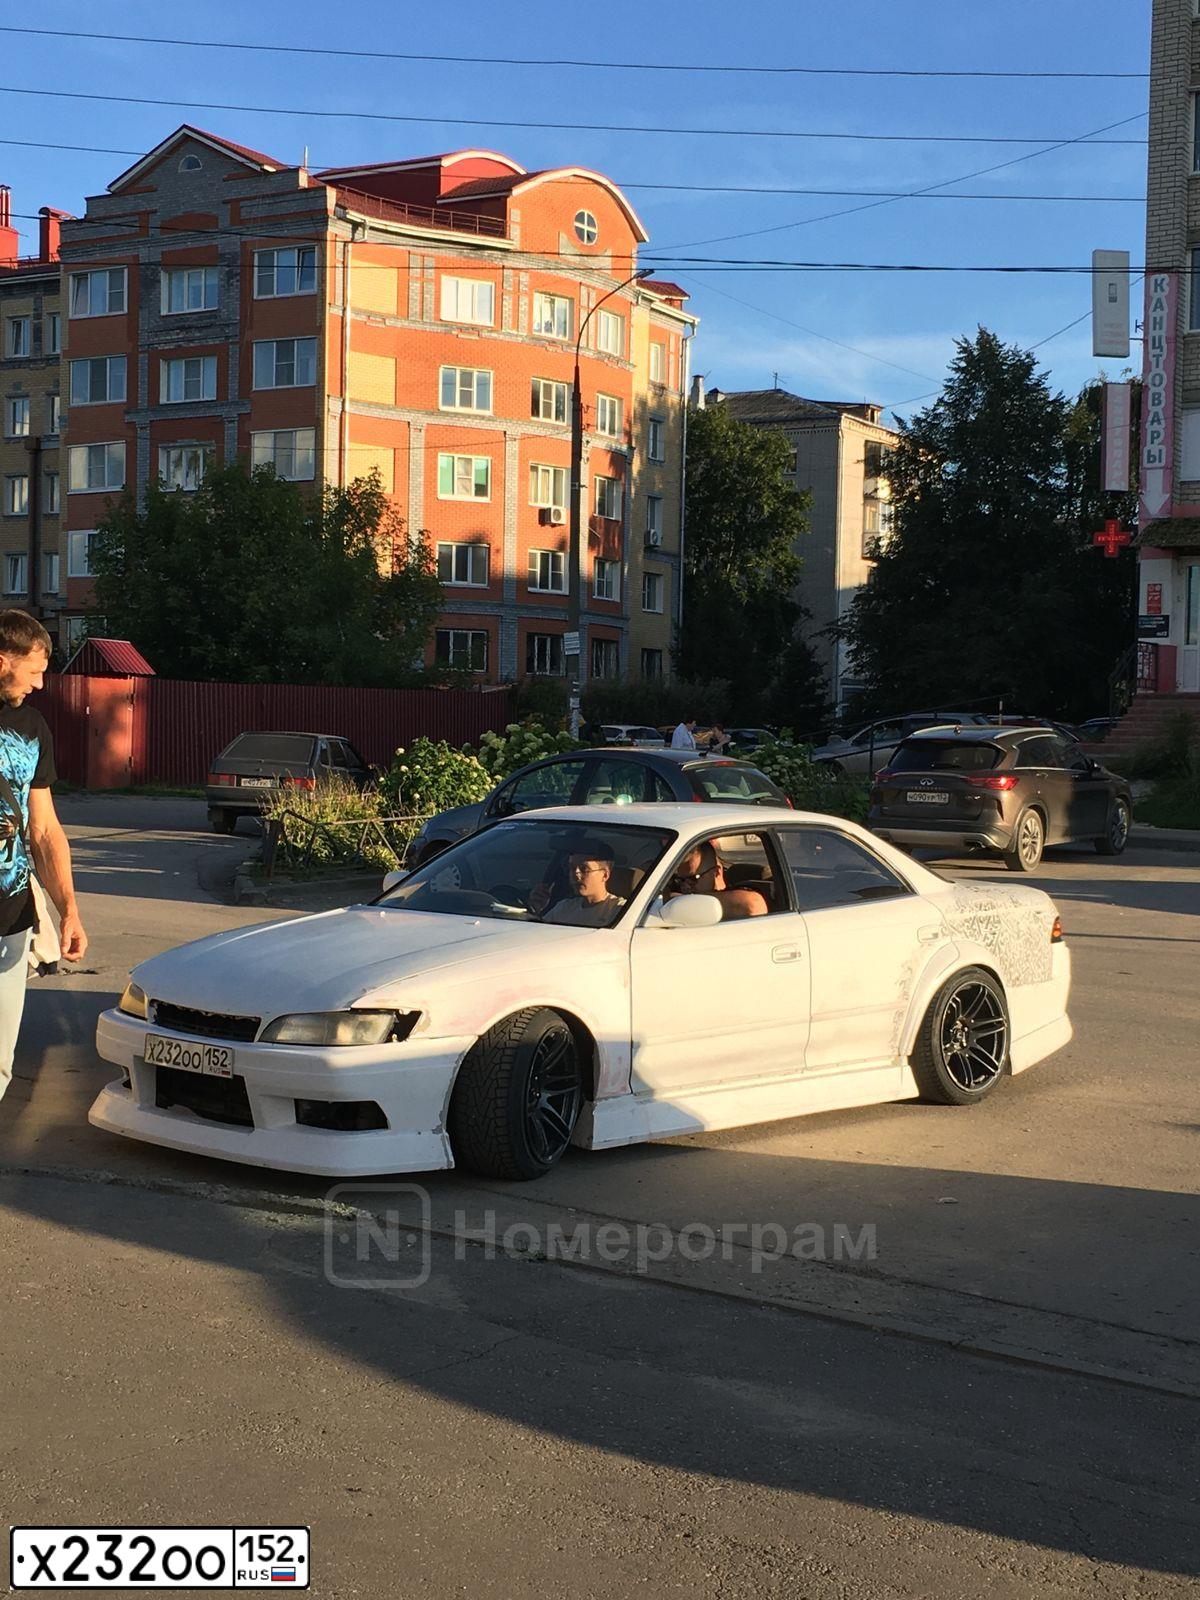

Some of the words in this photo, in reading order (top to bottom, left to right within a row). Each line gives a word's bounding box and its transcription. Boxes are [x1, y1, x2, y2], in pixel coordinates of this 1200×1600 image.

[1146, 277, 1166, 464] КАНЦТОВАРЫ
[148, 1040, 201, 1069] Х232ОО
[205, 1047, 228, 1067] 152
